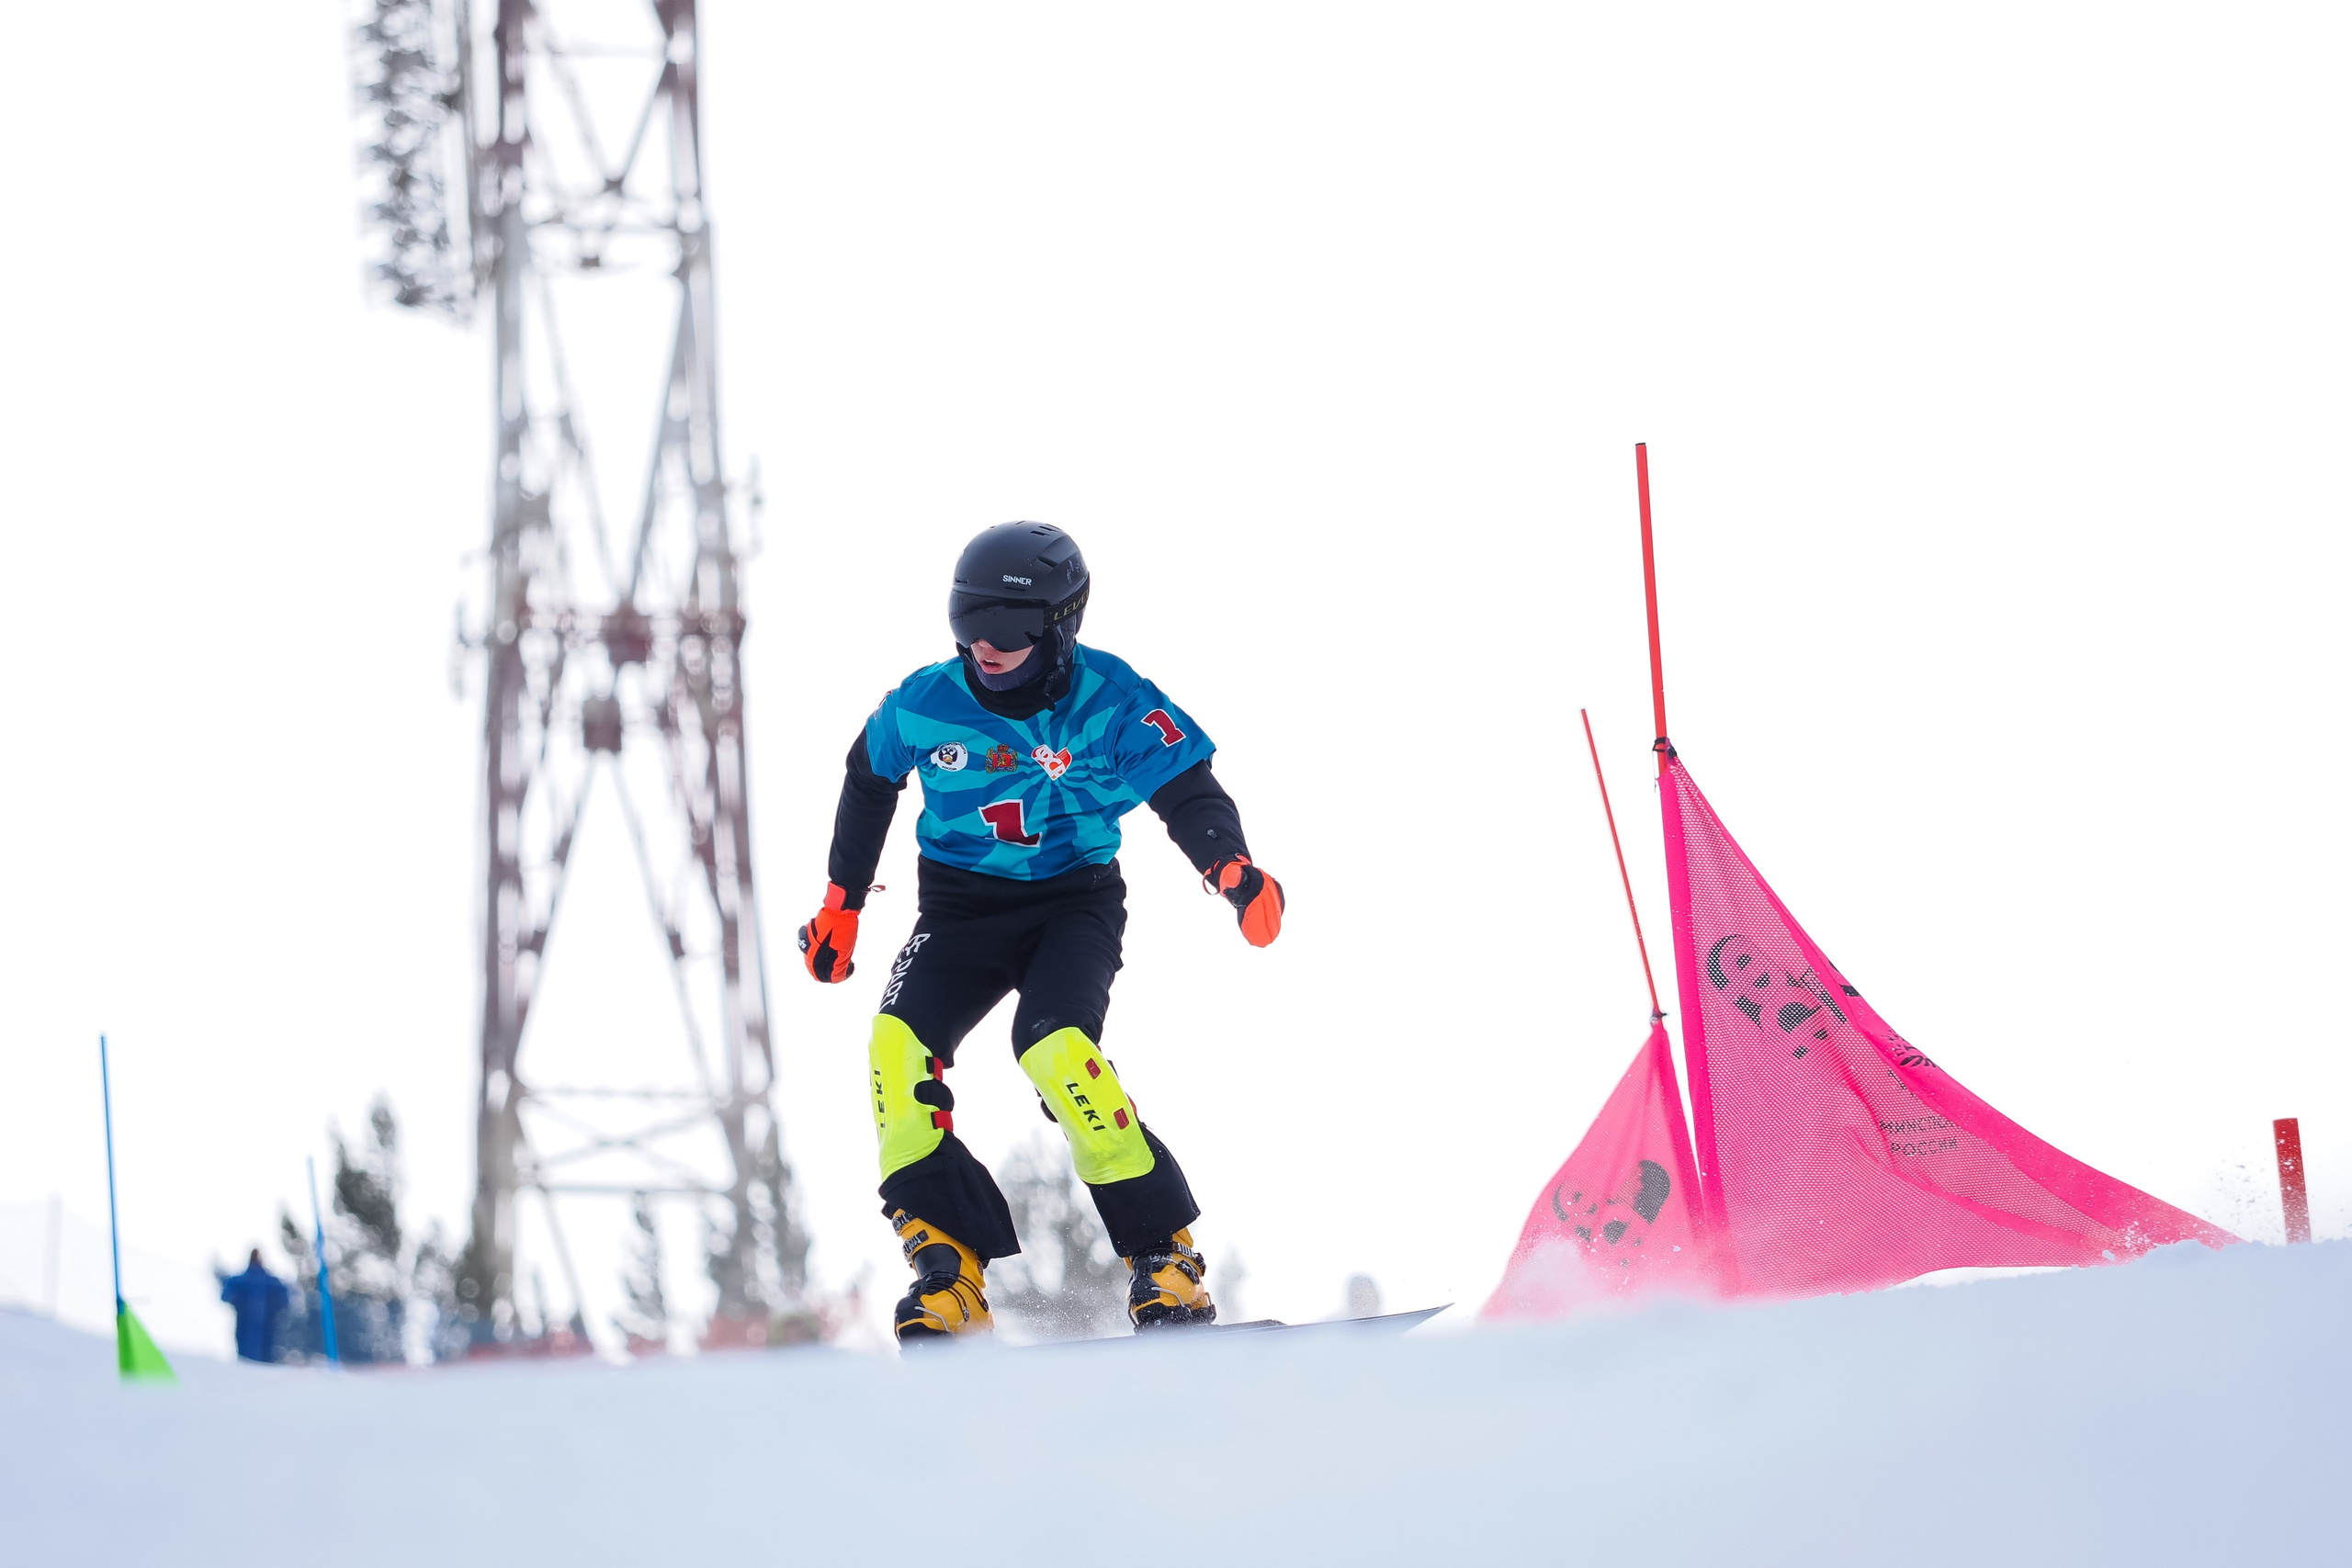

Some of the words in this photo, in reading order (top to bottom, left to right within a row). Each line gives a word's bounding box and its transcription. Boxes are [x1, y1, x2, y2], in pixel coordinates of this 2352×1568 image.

[1002, 574, 1032, 586] SINNER
[1141, 708, 1185, 747] 1
[978, 798, 1042, 847] 1
[874, 1069, 886, 1129] LEKI
[1066, 1082, 1106, 1131] LEKI
[1890, 1138, 1958, 1156] РОССИИ
